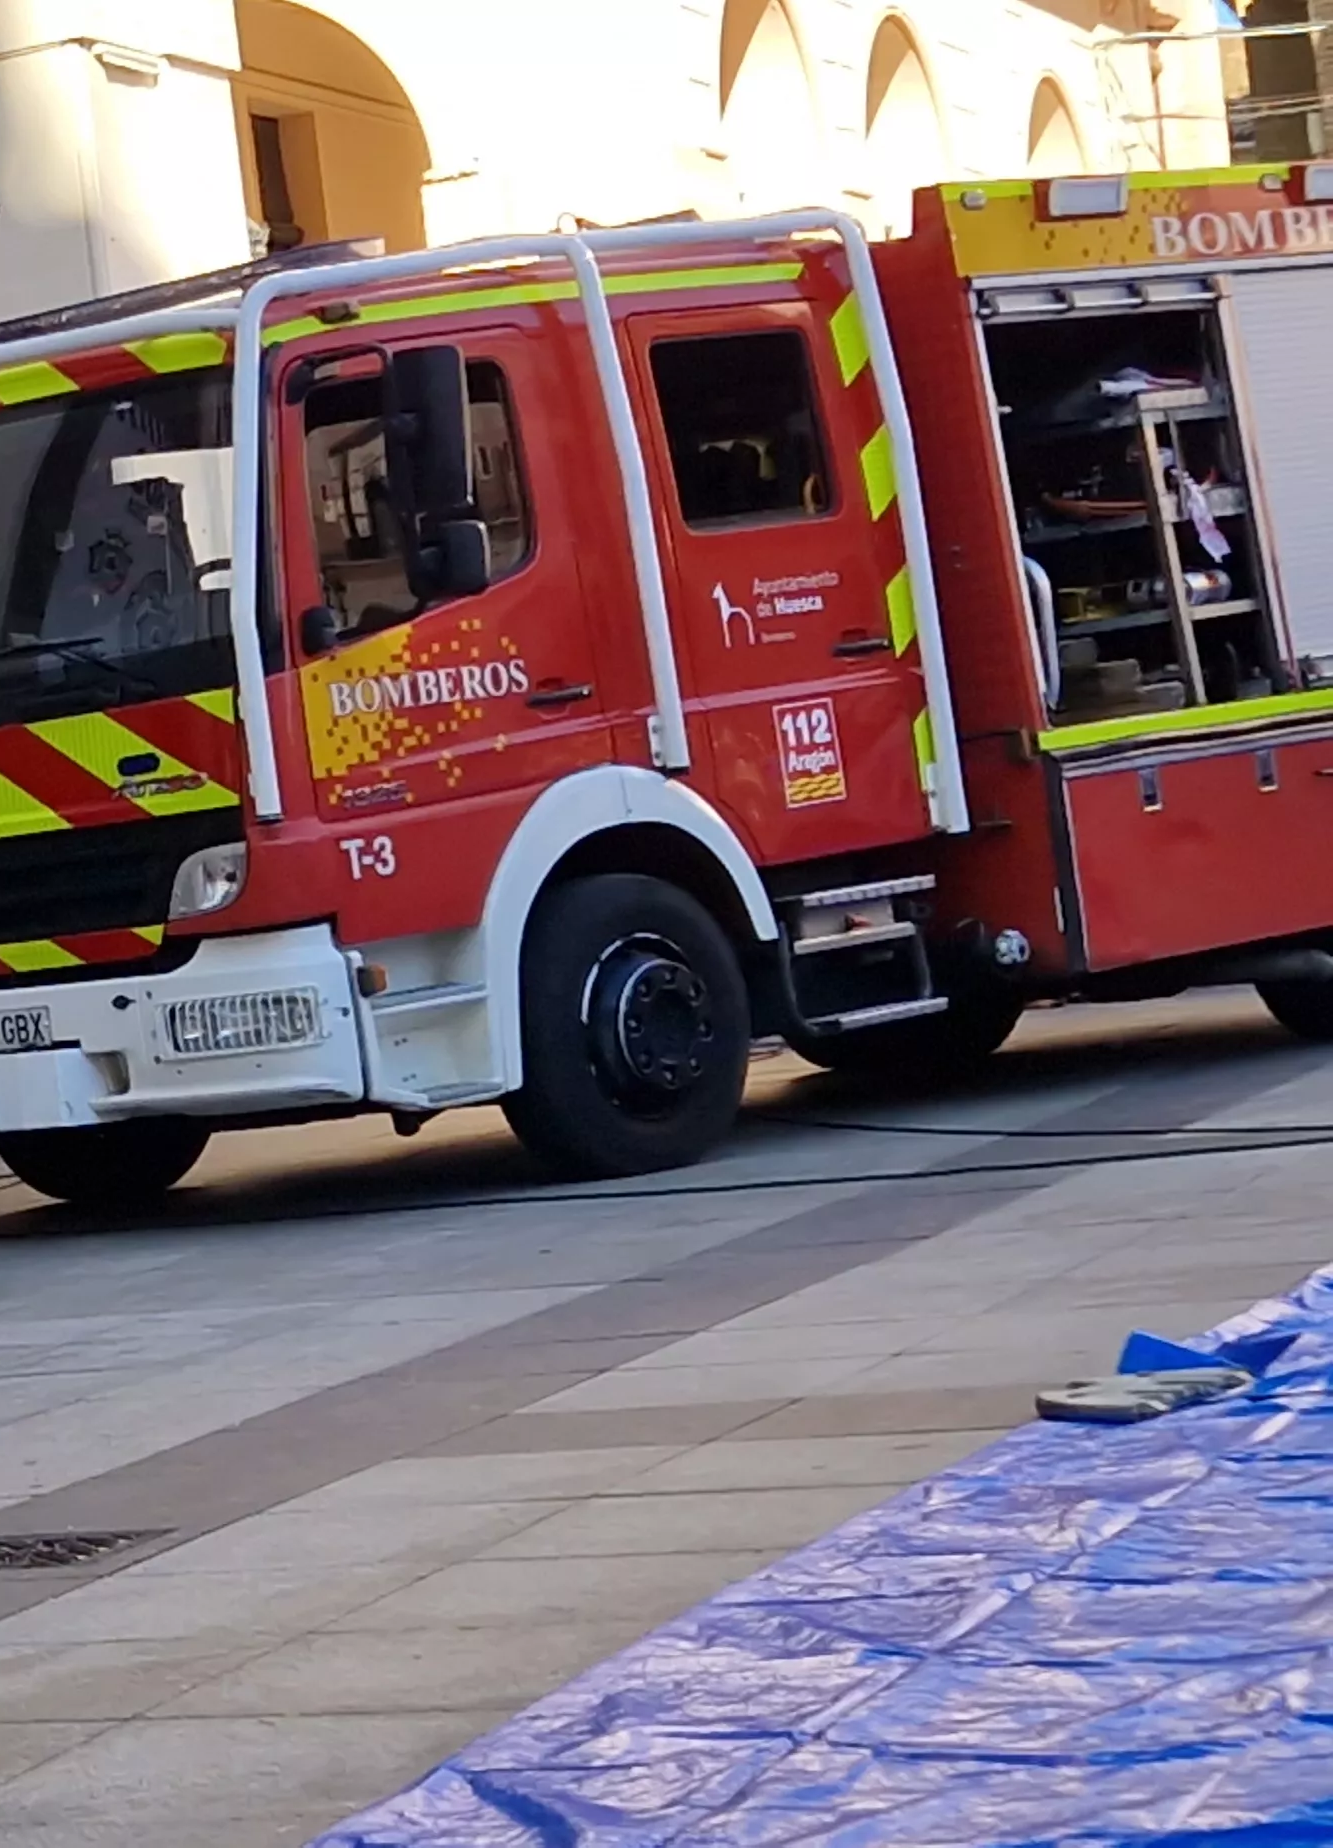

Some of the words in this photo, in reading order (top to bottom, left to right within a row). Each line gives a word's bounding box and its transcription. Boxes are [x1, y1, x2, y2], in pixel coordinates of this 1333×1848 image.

[329, 659, 529, 717] BOMBEROS
[782, 708, 832, 747] 112
[789, 748, 836, 773] Aragón
[339, 836, 396, 881] T-3
[0, 1012, 46, 1046] GBX
